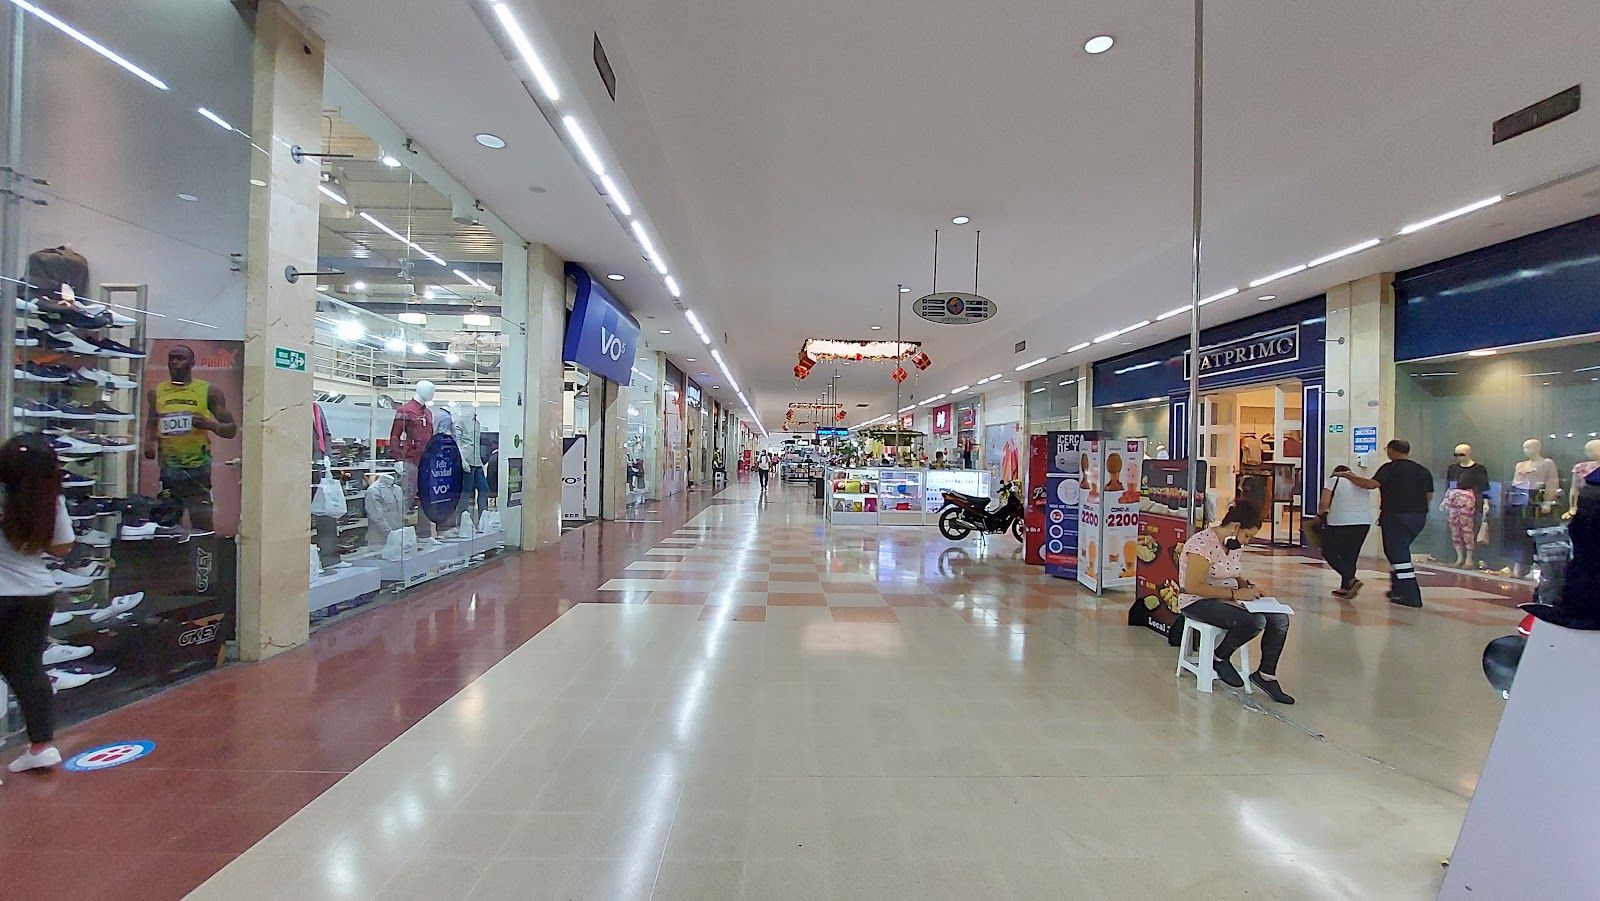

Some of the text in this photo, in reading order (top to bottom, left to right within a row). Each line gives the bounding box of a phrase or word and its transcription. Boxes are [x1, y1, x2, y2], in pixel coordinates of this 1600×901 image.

[1199, 337, 1294, 371] ATPRIMO
[164, 418, 189, 431] BOLT
[1082, 510, 1099, 527] 2200
[1148, 616, 1166, 633] Local
